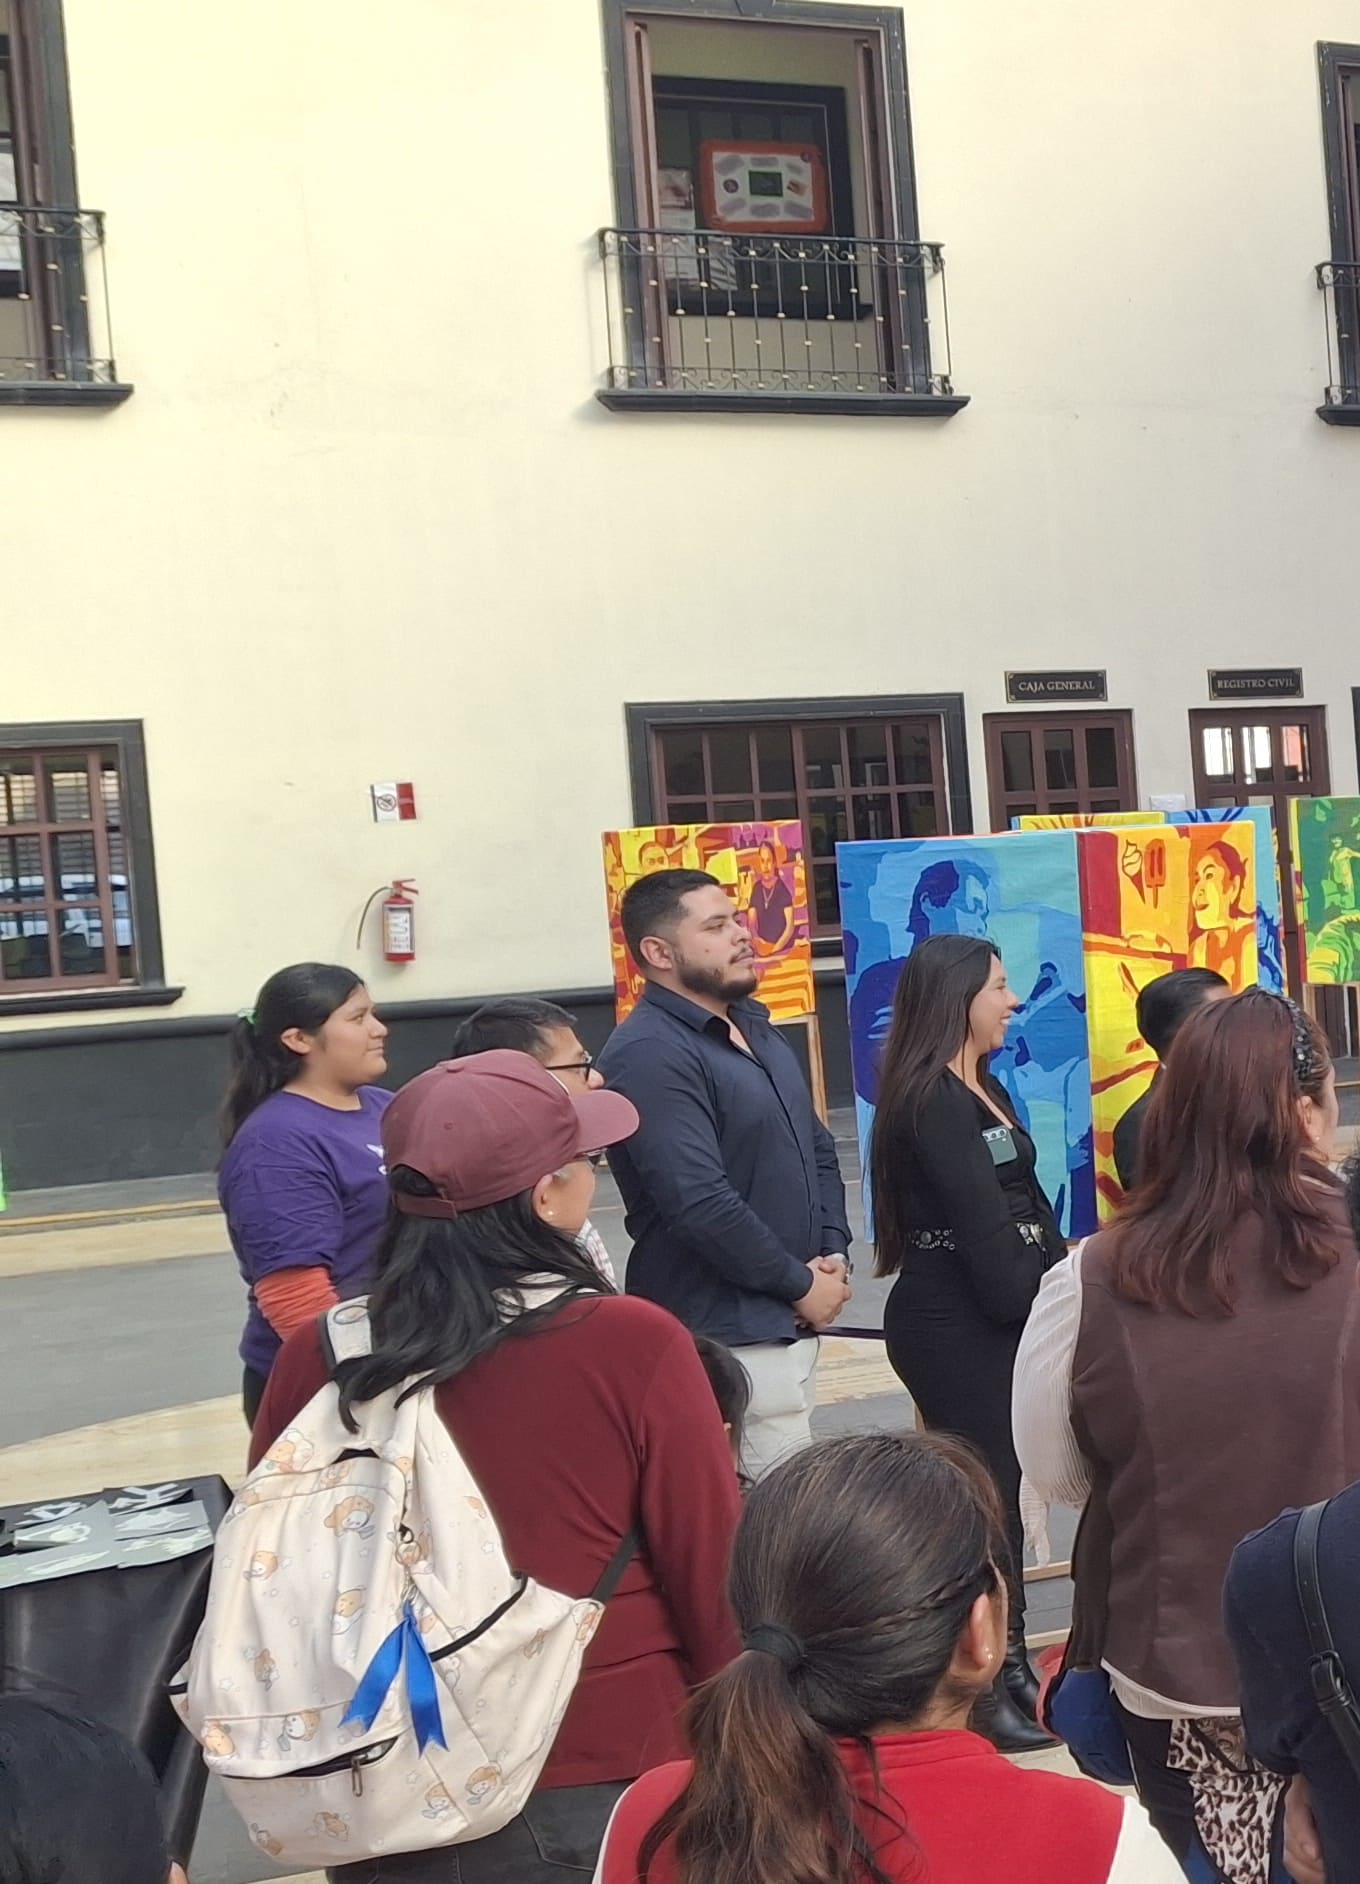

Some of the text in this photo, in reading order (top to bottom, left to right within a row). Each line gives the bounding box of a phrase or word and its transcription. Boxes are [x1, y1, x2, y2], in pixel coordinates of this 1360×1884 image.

[1018, 679, 1096, 693] CAJA GENERAL
[1217, 676, 1296, 690] REGISTRO CIVIL
